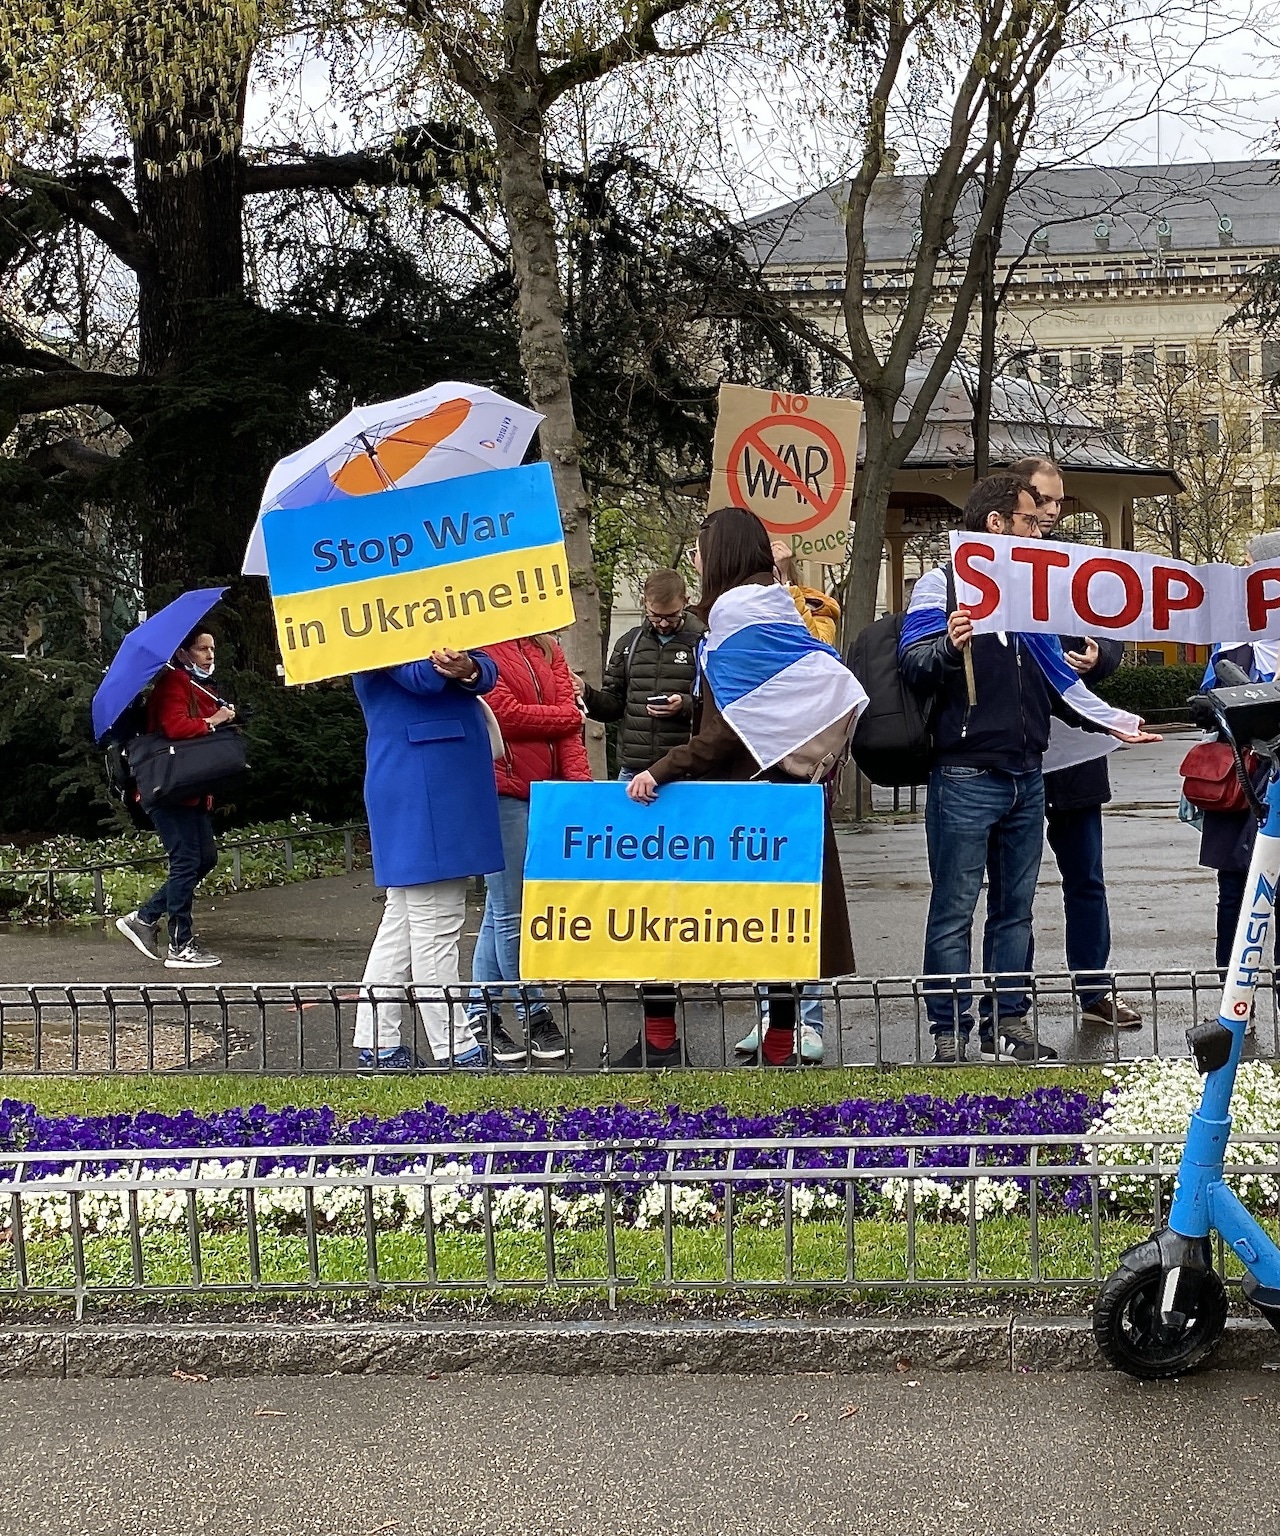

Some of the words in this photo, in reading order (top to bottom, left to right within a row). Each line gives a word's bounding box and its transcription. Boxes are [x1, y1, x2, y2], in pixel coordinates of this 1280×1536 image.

[771, 392, 809, 414] NO
[744, 444, 829, 505] WAR
[313, 531, 414, 573] Stop
[423, 511, 516, 549] War
[791, 529, 848, 557] Peace
[284, 617, 327, 650] in
[340, 564, 565, 638] Ukraine!!!
[955, 541, 1205, 632] STOP
[563, 825, 715, 861] Frieden
[729, 825, 788, 861] für
[530, 906, 592, 941] die
[608, 907, 812, 943] Ukraine!!!
[1236, 872, 1279, 986] ZISCH
